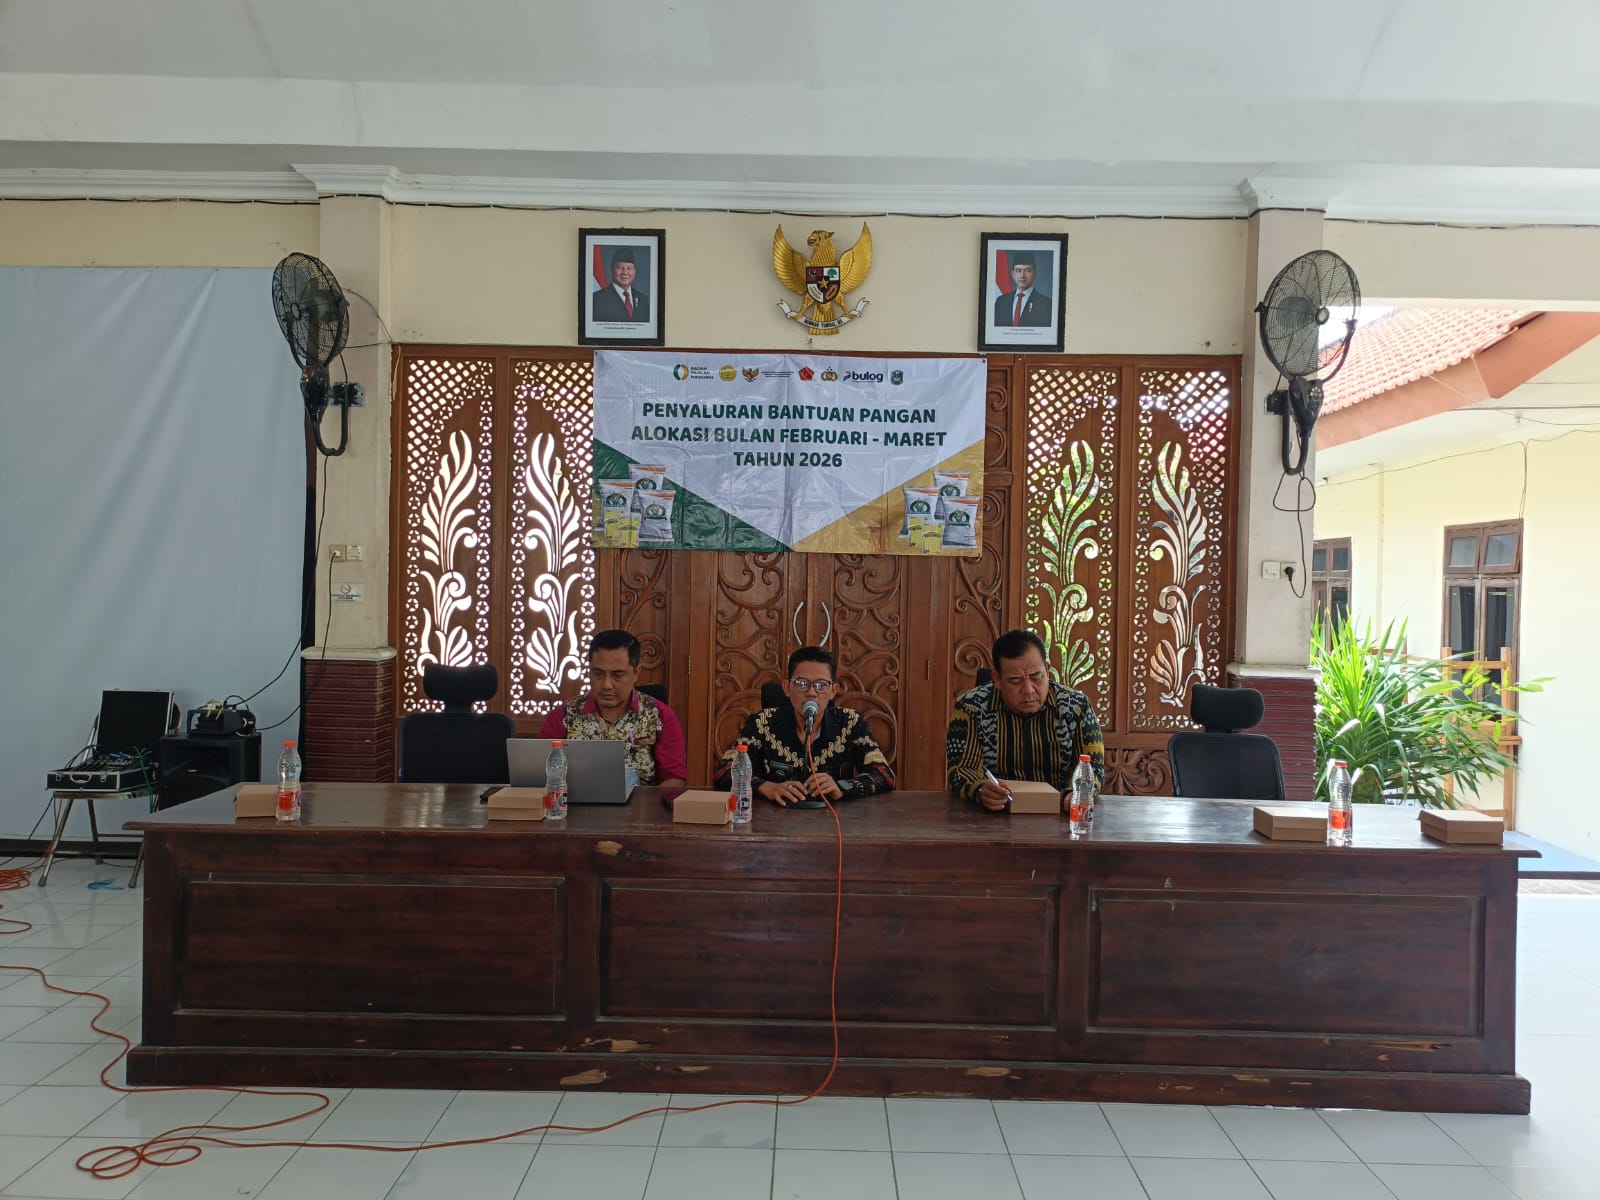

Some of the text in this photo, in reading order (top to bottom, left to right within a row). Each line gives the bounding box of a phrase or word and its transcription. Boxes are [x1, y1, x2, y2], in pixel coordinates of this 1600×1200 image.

[852, 371, 884, 383] bulog
[642, 402, 936, 423] PENYALURAN BANTUAN PANGAN
[631, 425, 709, 442] ALOKASI
[714, 427, 775, 443] BULAN
[780, 428, 868, 446] FEBRUARI
[883, 431, 947, 447] MARET
[733, 451, 842, 467] TAHUN 2026
